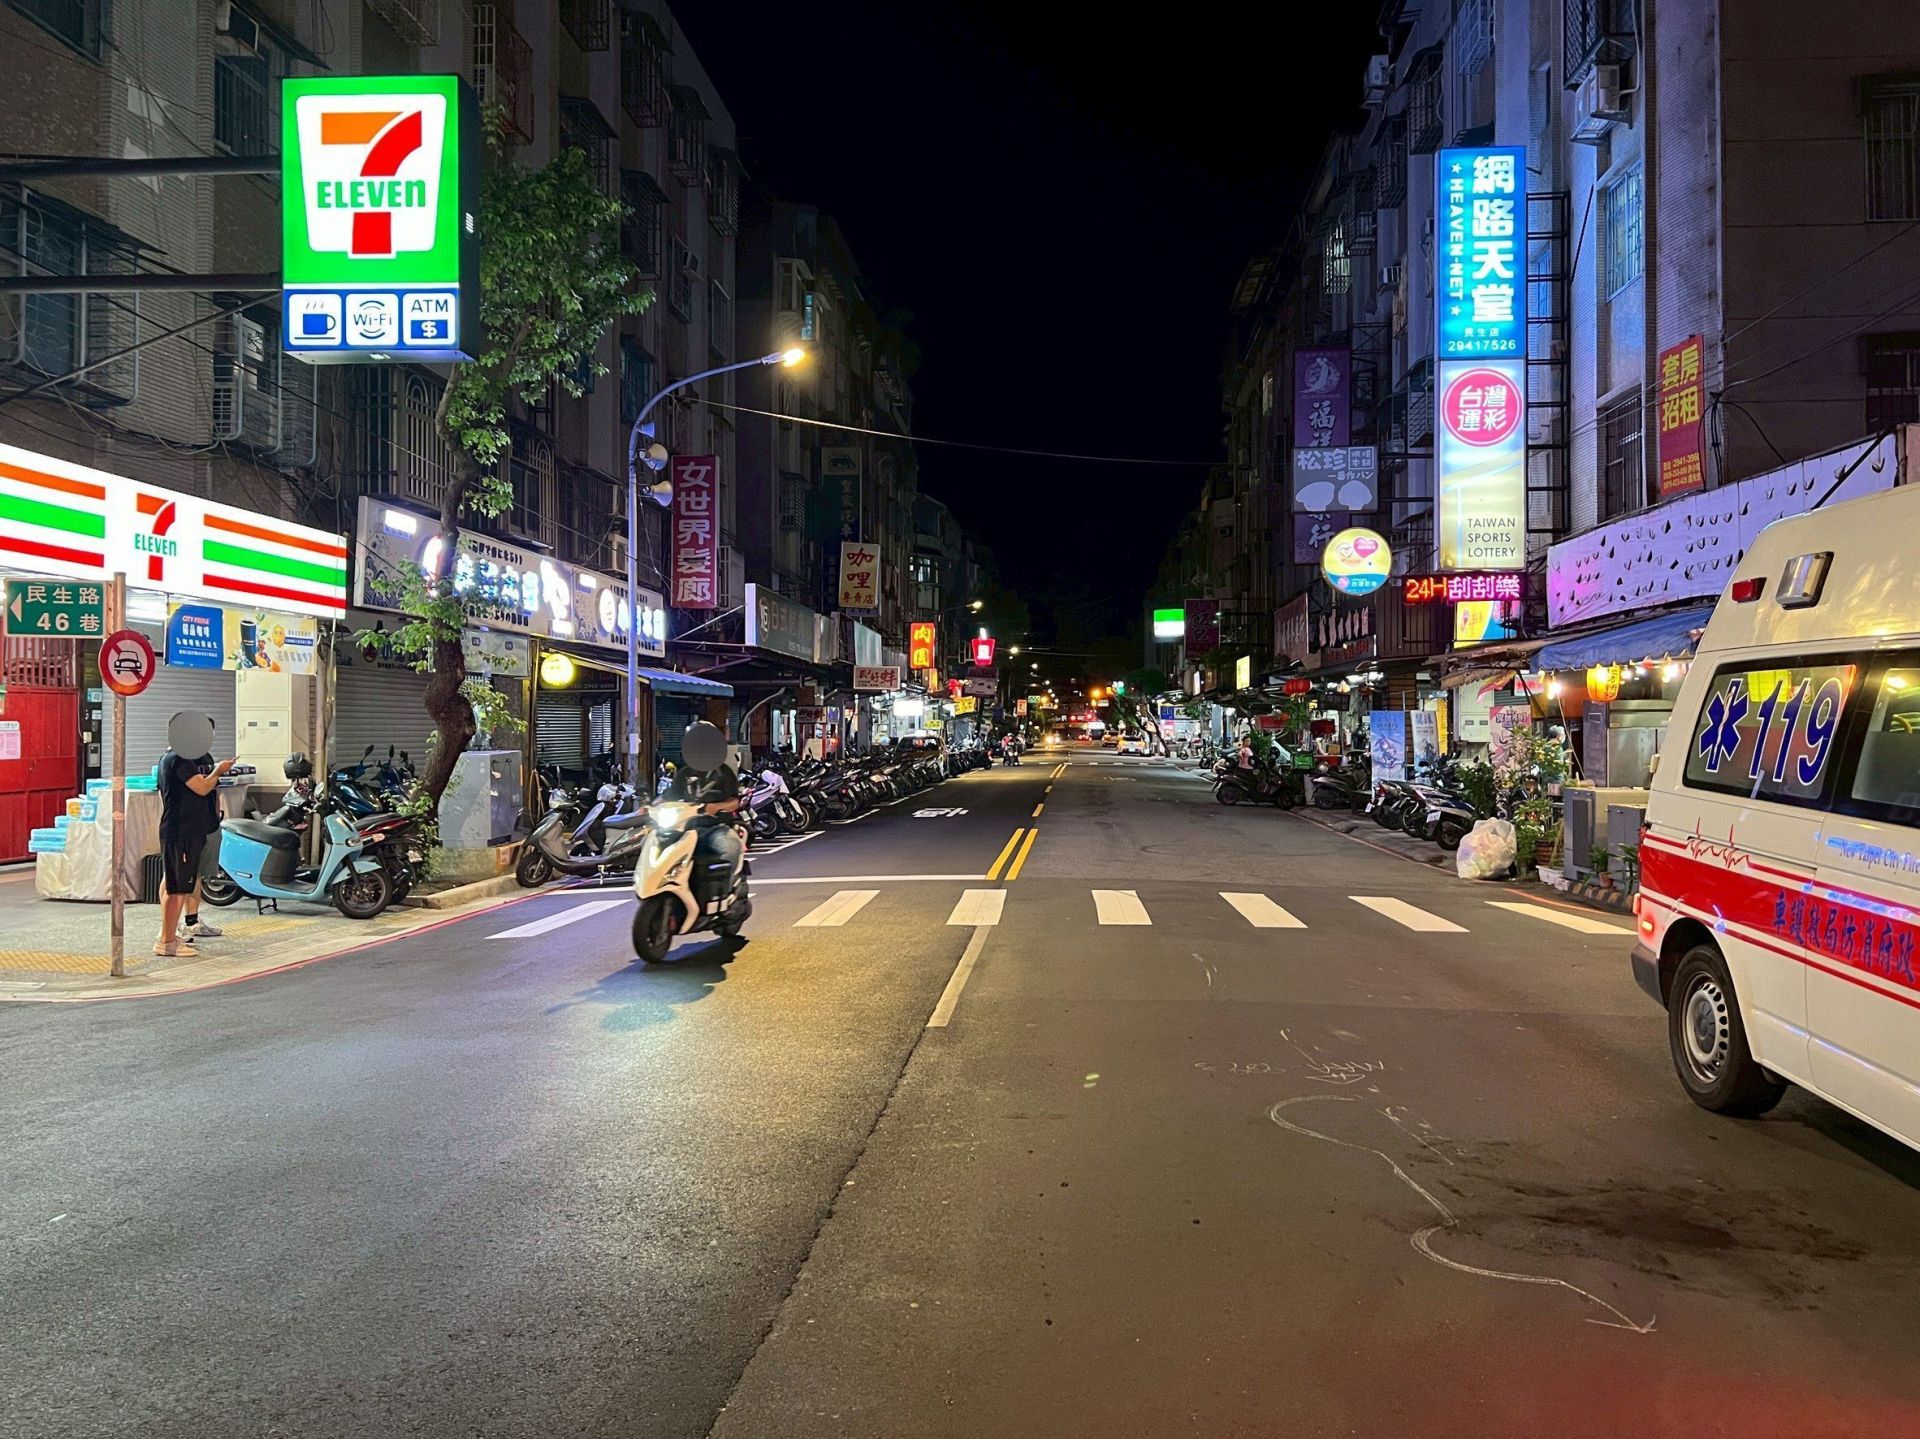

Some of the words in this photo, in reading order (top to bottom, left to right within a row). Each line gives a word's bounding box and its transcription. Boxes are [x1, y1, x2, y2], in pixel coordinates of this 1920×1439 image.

[320, 110, 422, 255] 7
[1450, 178, 1465, 302] HEAVEN-NET
[1472, 154, 1516, 323] 網路天堂
[411, 299, 449, 313] ATM
[353, 313, 392, 326] Wi-Fi
[1463, 327, 1500, 337] 民生店
[1447, 339, 1517, 351] 29417526
[1662, 343, 1699, 391] 套房
[1662, 385, 1700, 432] 招租
[1297, 448, 1347, 471] 松珍
[676, 460, 712, 602] 女世界髮廊
[1466, 517, 1516, 529] TAIWAN
[1467, 531, 1512, 543] SPORTS
[1466, 546, 1517, 558] LOTTERY
[846, 547, 875, 588] 咖哩
[26, 585, 100, 605] 民生路
[36, 612, 70, 632] 46
[79, 613, 100, 632] 巷
[1748, 676, 1842, 786] 119
[1883, 849, 1900, 875] City
